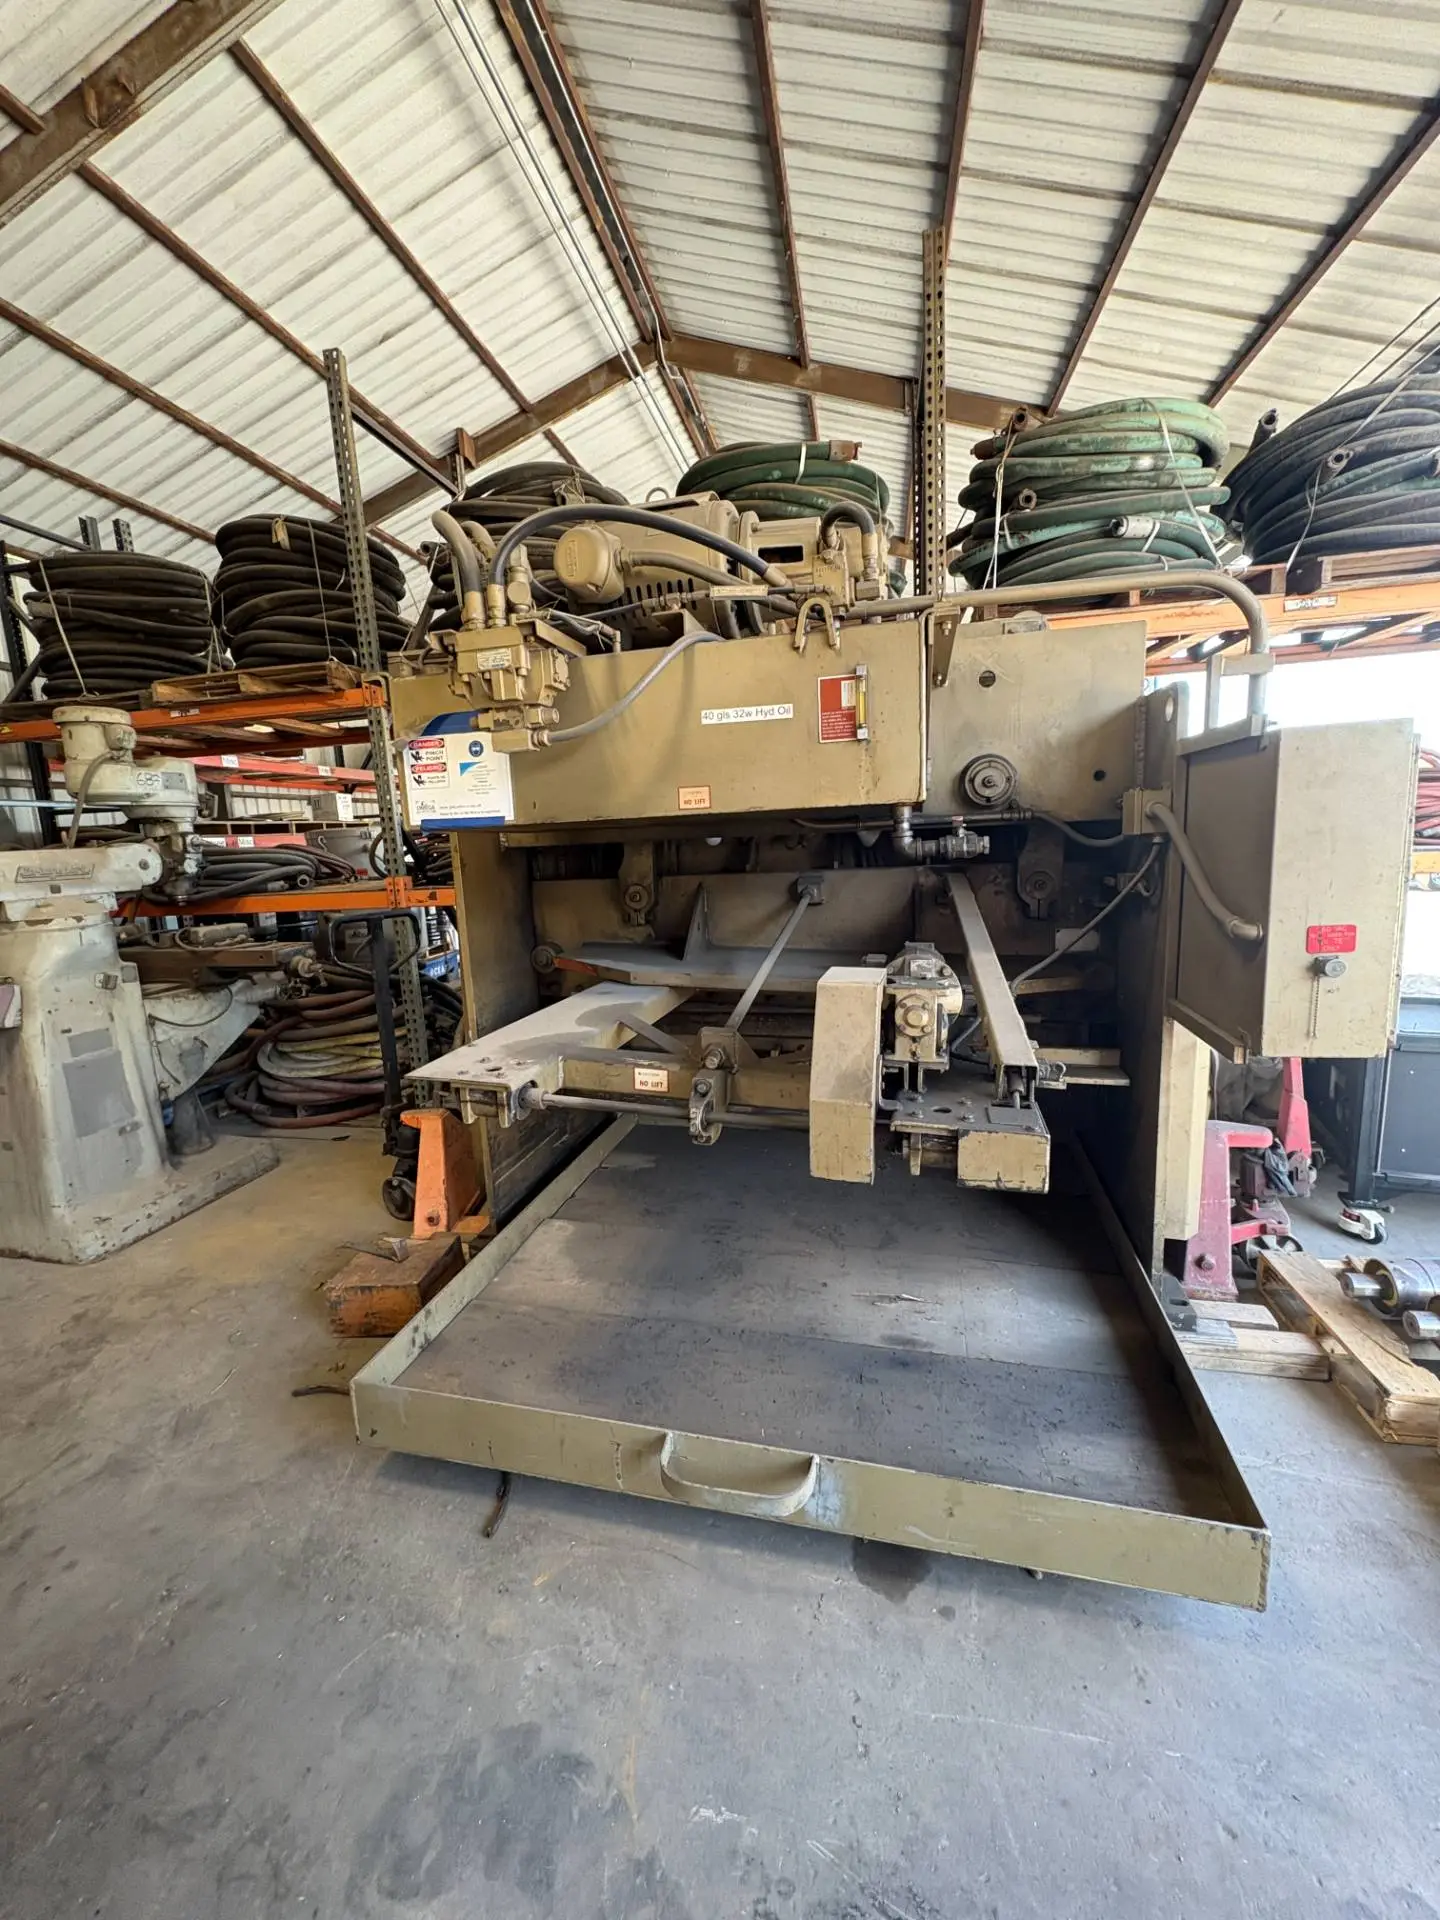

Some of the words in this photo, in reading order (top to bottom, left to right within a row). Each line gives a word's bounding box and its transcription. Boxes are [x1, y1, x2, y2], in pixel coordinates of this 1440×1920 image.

[702, 711, 714, 720] 40
[717, 711, 730, 721] gls
[733, 709, 752, 719] 32w
[755, 707, 774, 719] Hyd
[777, 705, 791, 715] Oil
[412, 740, 440, 748] DANGER
[415, 764, 444, 773] PELIGRO
[639, 1079, 649, 1087] NO
[650, 1080, 664, 1088] LIFT
